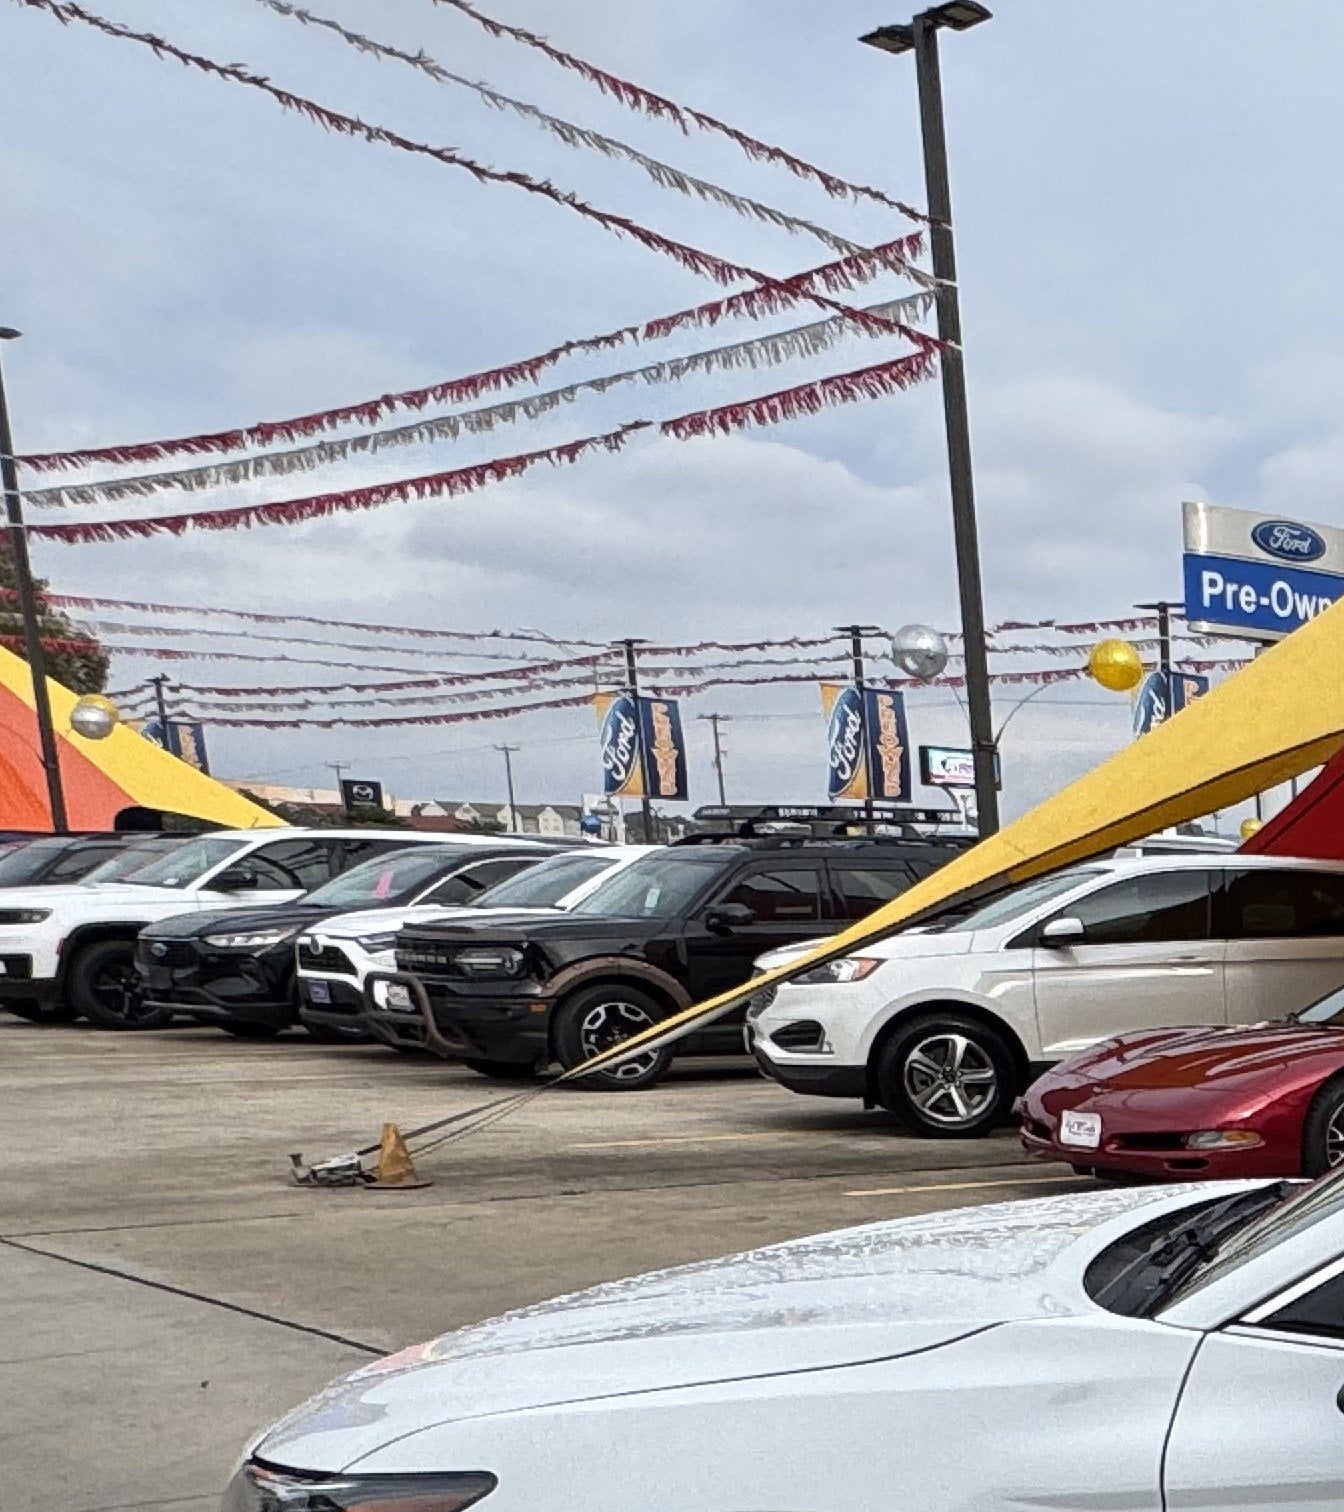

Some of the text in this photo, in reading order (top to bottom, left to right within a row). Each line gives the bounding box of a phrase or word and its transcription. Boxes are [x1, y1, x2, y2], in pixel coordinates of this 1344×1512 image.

[1269, 526, 1312, 553] Ford
[1202, 570, 1334, 622] Pre-Own
[602, 711, 636, 781] Ford
[829, 704, 862, 781] Ford
